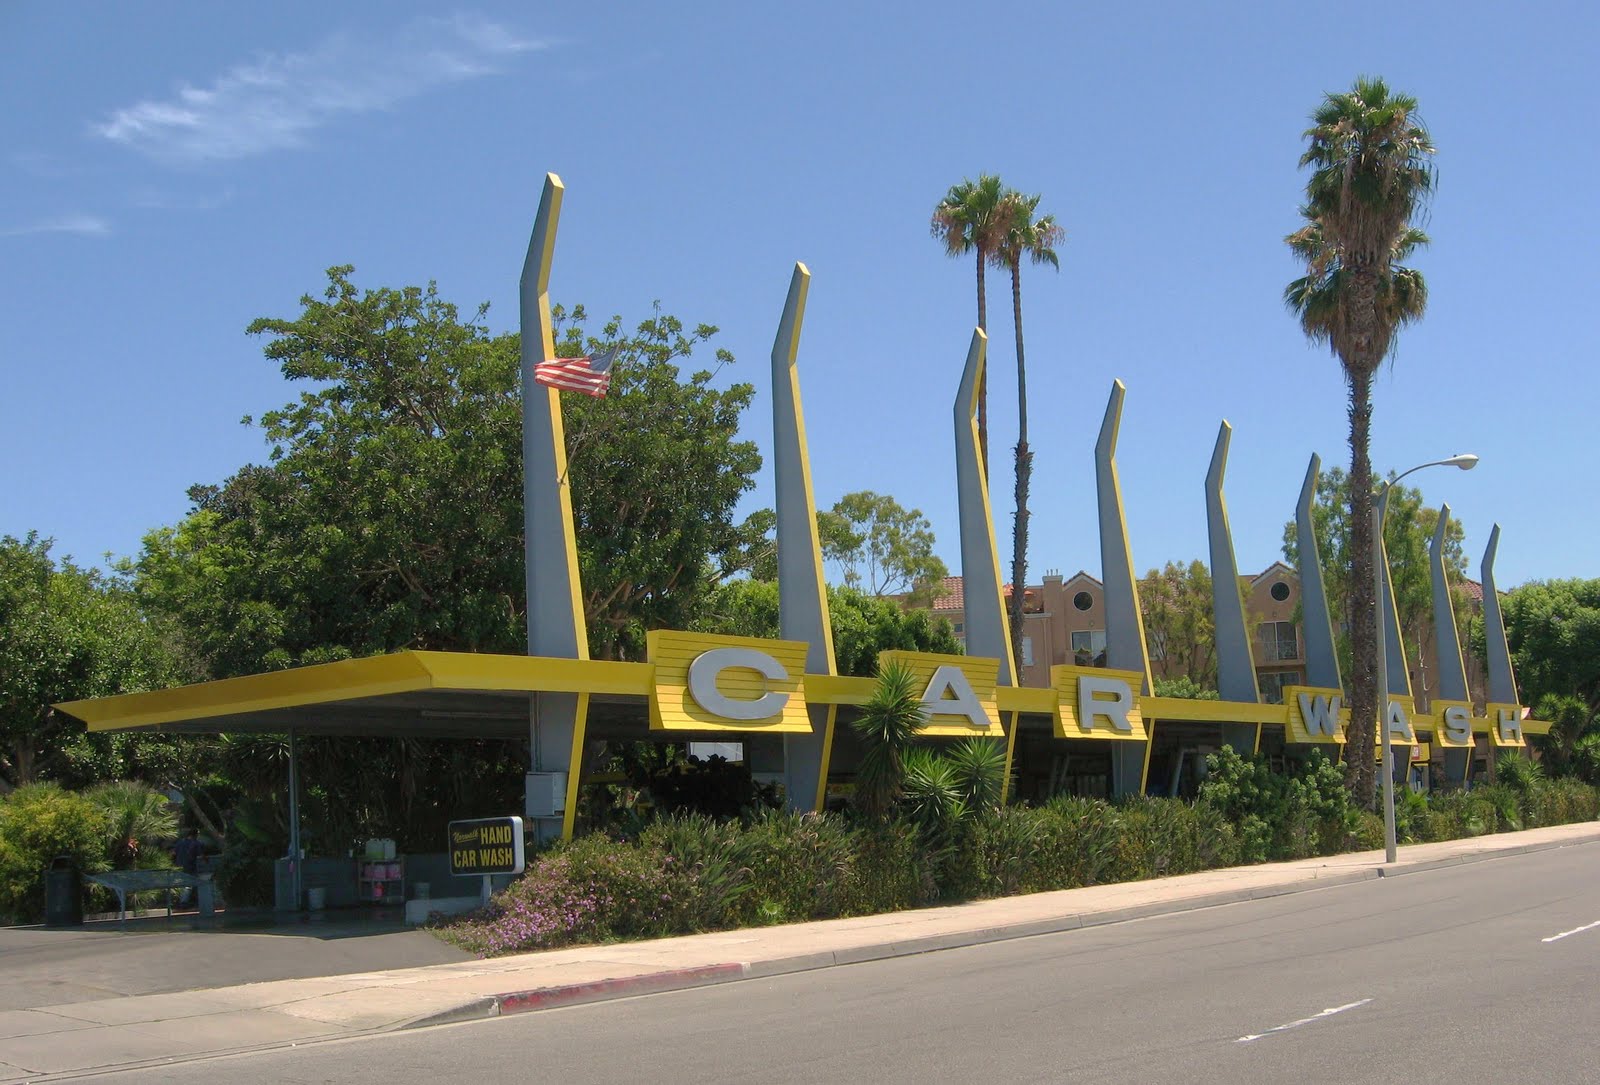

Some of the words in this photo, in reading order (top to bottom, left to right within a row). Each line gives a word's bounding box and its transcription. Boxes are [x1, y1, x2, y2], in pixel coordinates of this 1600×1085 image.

[688, 648, 1133, 731] CAR
[1298, 693, 1521, 744] WASH
[480, 826, 512, 844] HAND
[454, 850, 476, 868] CAR
[480, 848, 513, 867] WASH
